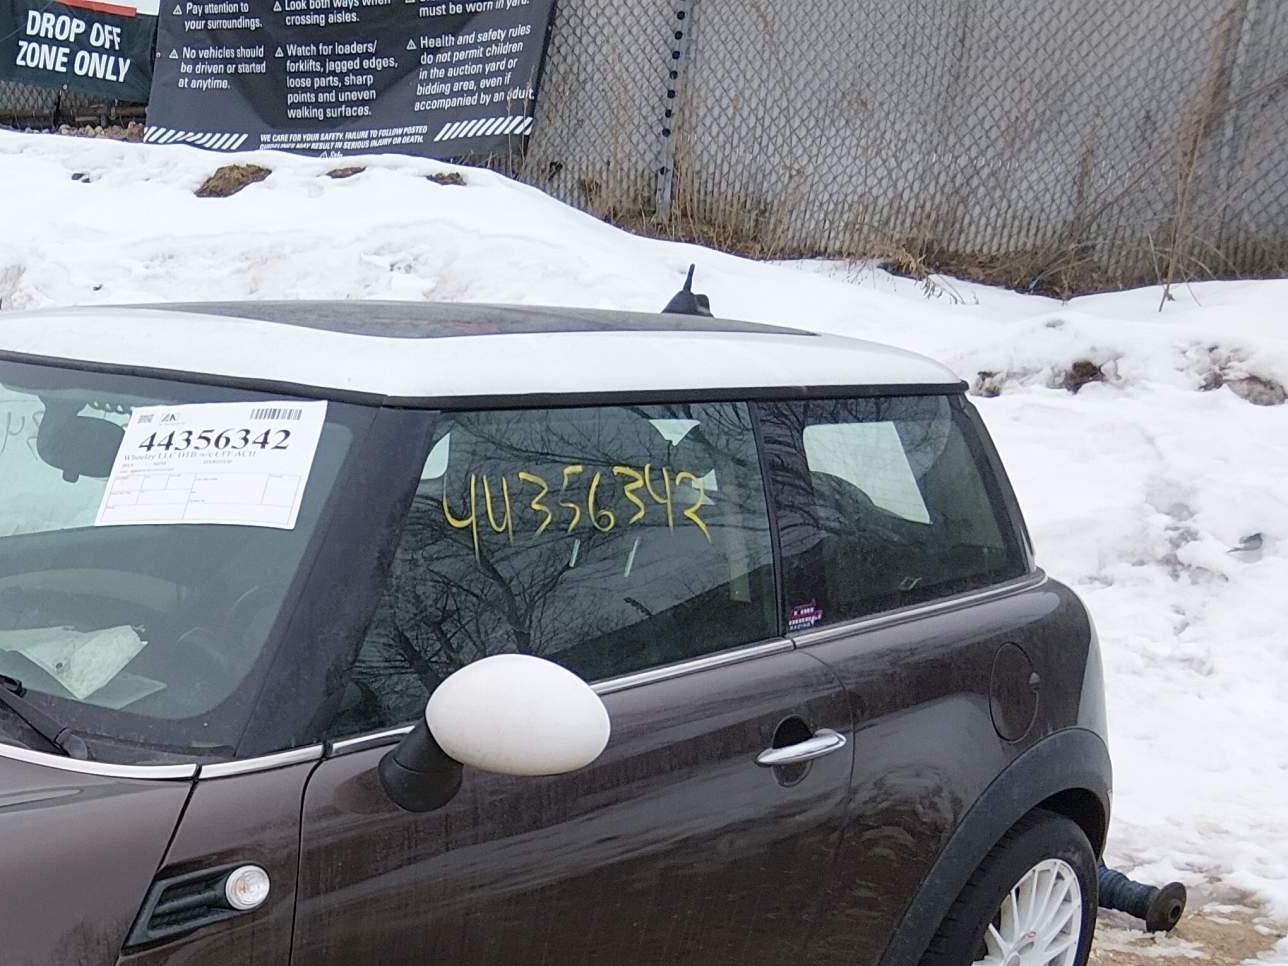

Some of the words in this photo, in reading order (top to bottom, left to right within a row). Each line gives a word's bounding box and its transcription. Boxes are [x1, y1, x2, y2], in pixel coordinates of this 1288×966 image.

[186, 2, 203, 16] Pay
[204, 1, 239, 14] attention
[241, 2, 249, 13] to
[285, 0, 307, 10] Look
[419, 3, 447, 17] must
[449, 2, 463, 14] be
[465, 0, 493, 13] worn
[185, 19, 206, 32] your
[207, 16, 263, 31] surroundings.
[285, 12, 326, 26] crossing
[328, 10, 360, 23] aisles.
[26, 10, 86, 43] DROP
[89, 22, 121, 50] OFF
[420, 34, 455, 49] Health
[457, 32, 475, 46] and
[477, 28, 507, 42] safety
[508, 24, 532, 38] rules
[182, 46, 197, 59] No
[198, 46, 235, 59] vehicles
[236, 45, 265, 58] should
[286, 43, 317, 57] Watch
[319, 43, 333, 56] for
[335, 39, 378, 55] loaders/
[420, 52, 433, 65] do
[435, 51, 451, 64] not
[452, 46, 484, 64] permit
[485, 41, 524, 57] children
[16, 40, 70, 73] ZONE
[73, 50, 131, 83] ONLY
[181, 61, 193, 74] be
[195, 61, 224, 74] driven
[226, 64, 236, 74] or
[237, 60, 266, 74] started
[286, 60, 324, 73] forklifts,
[325, 57, 360, 73] jagged
[363, 56, 399, 71] edges,
[419, 68, 428, 80] in
[429, 66, 445, 79] the
[447, 62, 483, 77] auction
[484, 58, 507, 75] yard
[507, 57, 519, 69] or
[178, 77, 189, 88] at
[190, 76, 231, 91] anytime.
[286, 75, 312, 88] loose
[314, 75, 342, 89] parts,
[344, 73, 374, 87] sharp
[416, 83, 451, 96] bidding
[452, 79, 477, 92] area,
[479, 76, 503, 89] even
[504, 71, 512, 85] if
[287, 91, 316, 105] points
[318, 90, 336, 102] and
[338, 90, 376, 102] uneven
[414, 93, 478, 112] accompanied
[479, 91, 491, 106] by
[493, 90, 505, 102] an
[287, 106, 324, 120] walking
[326, 104, 372, 118] surfaces.
[138, 427, 292, 452] 44356342
[443, 464, 712, 567] 44356342
